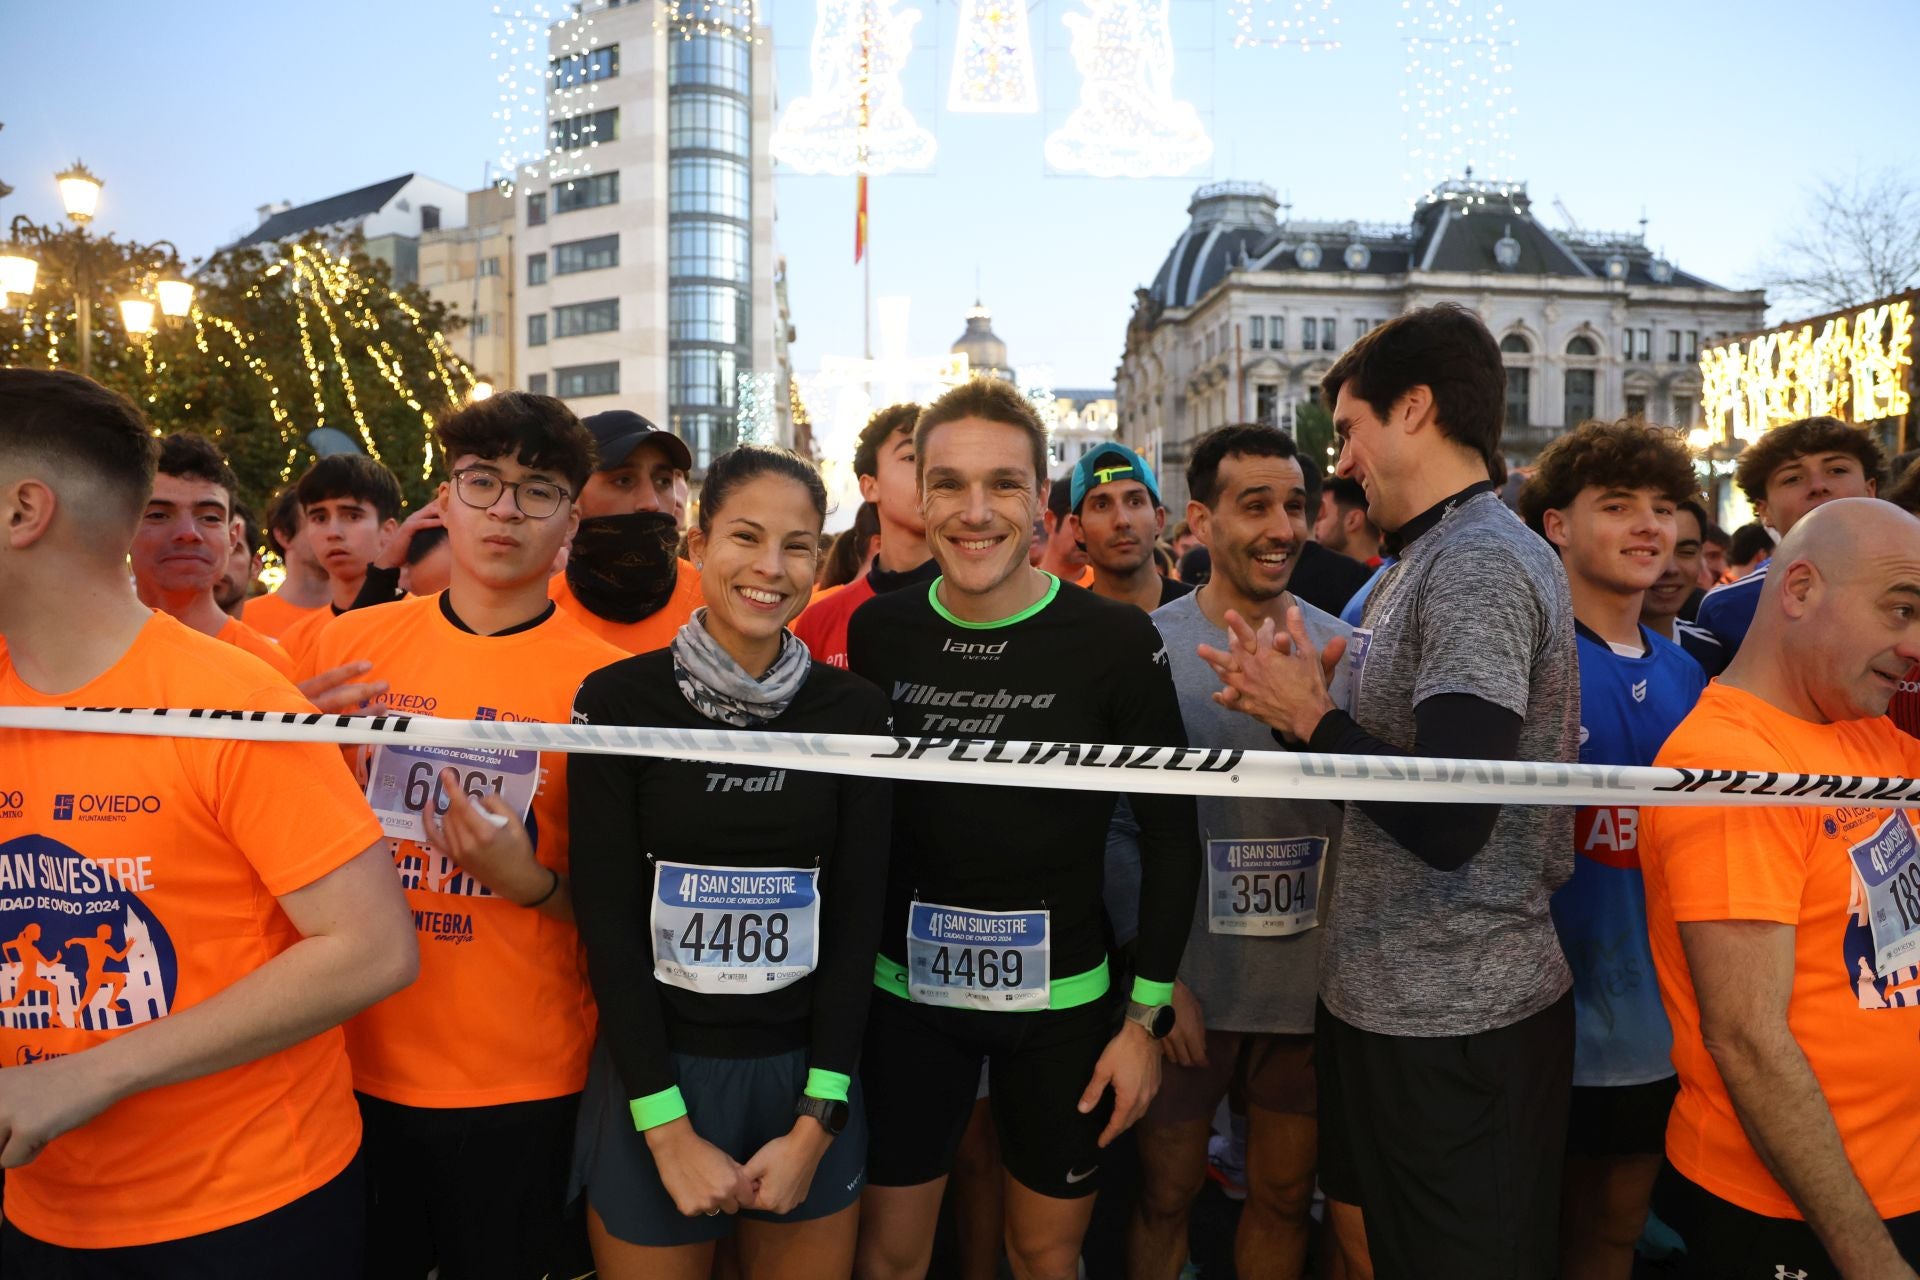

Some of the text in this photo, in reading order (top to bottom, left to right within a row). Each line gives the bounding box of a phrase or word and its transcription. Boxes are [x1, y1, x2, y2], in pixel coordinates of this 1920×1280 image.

[943, 638, 1009, 655] land
[375, 693, 437, 711] OVIEDO
[892, 680, 1057, 710] VillaCabra
[922, 713, 1006, 735] Trail
[705, 770, 787, 792] Trail
[79, 794, 161, 814] OVIEDO
[78, 814, 127, 822] AYUNTAMIENTO
[1583, 808, 1639, 851] AB
[1227, 842, 1311, 868] 41 SAN SILVESTRE
[1870, 843, 1889, 876] 41
[38, 853, 155, 895] SILVESTRE
[679, 873, 797, 903] 41 SAN SILVESTRE
[698, 895, 725, 904] CIUDAD
[737, 897, 764, 905] OVIEDO
[1231, 871, 1307, 914] 3504
[37, 896, 51, 910] DE
[51, 900, 83, 916] OVIEDO
[85, 899, 121, 915] 2024
[411, 909, 473, 935] NTEGRA
[928, 912, 1028, 938] 41 SAN SILVESTRE
[679, 912, 789, 964] 4468
[931, 946, 1024, 989] 4469
